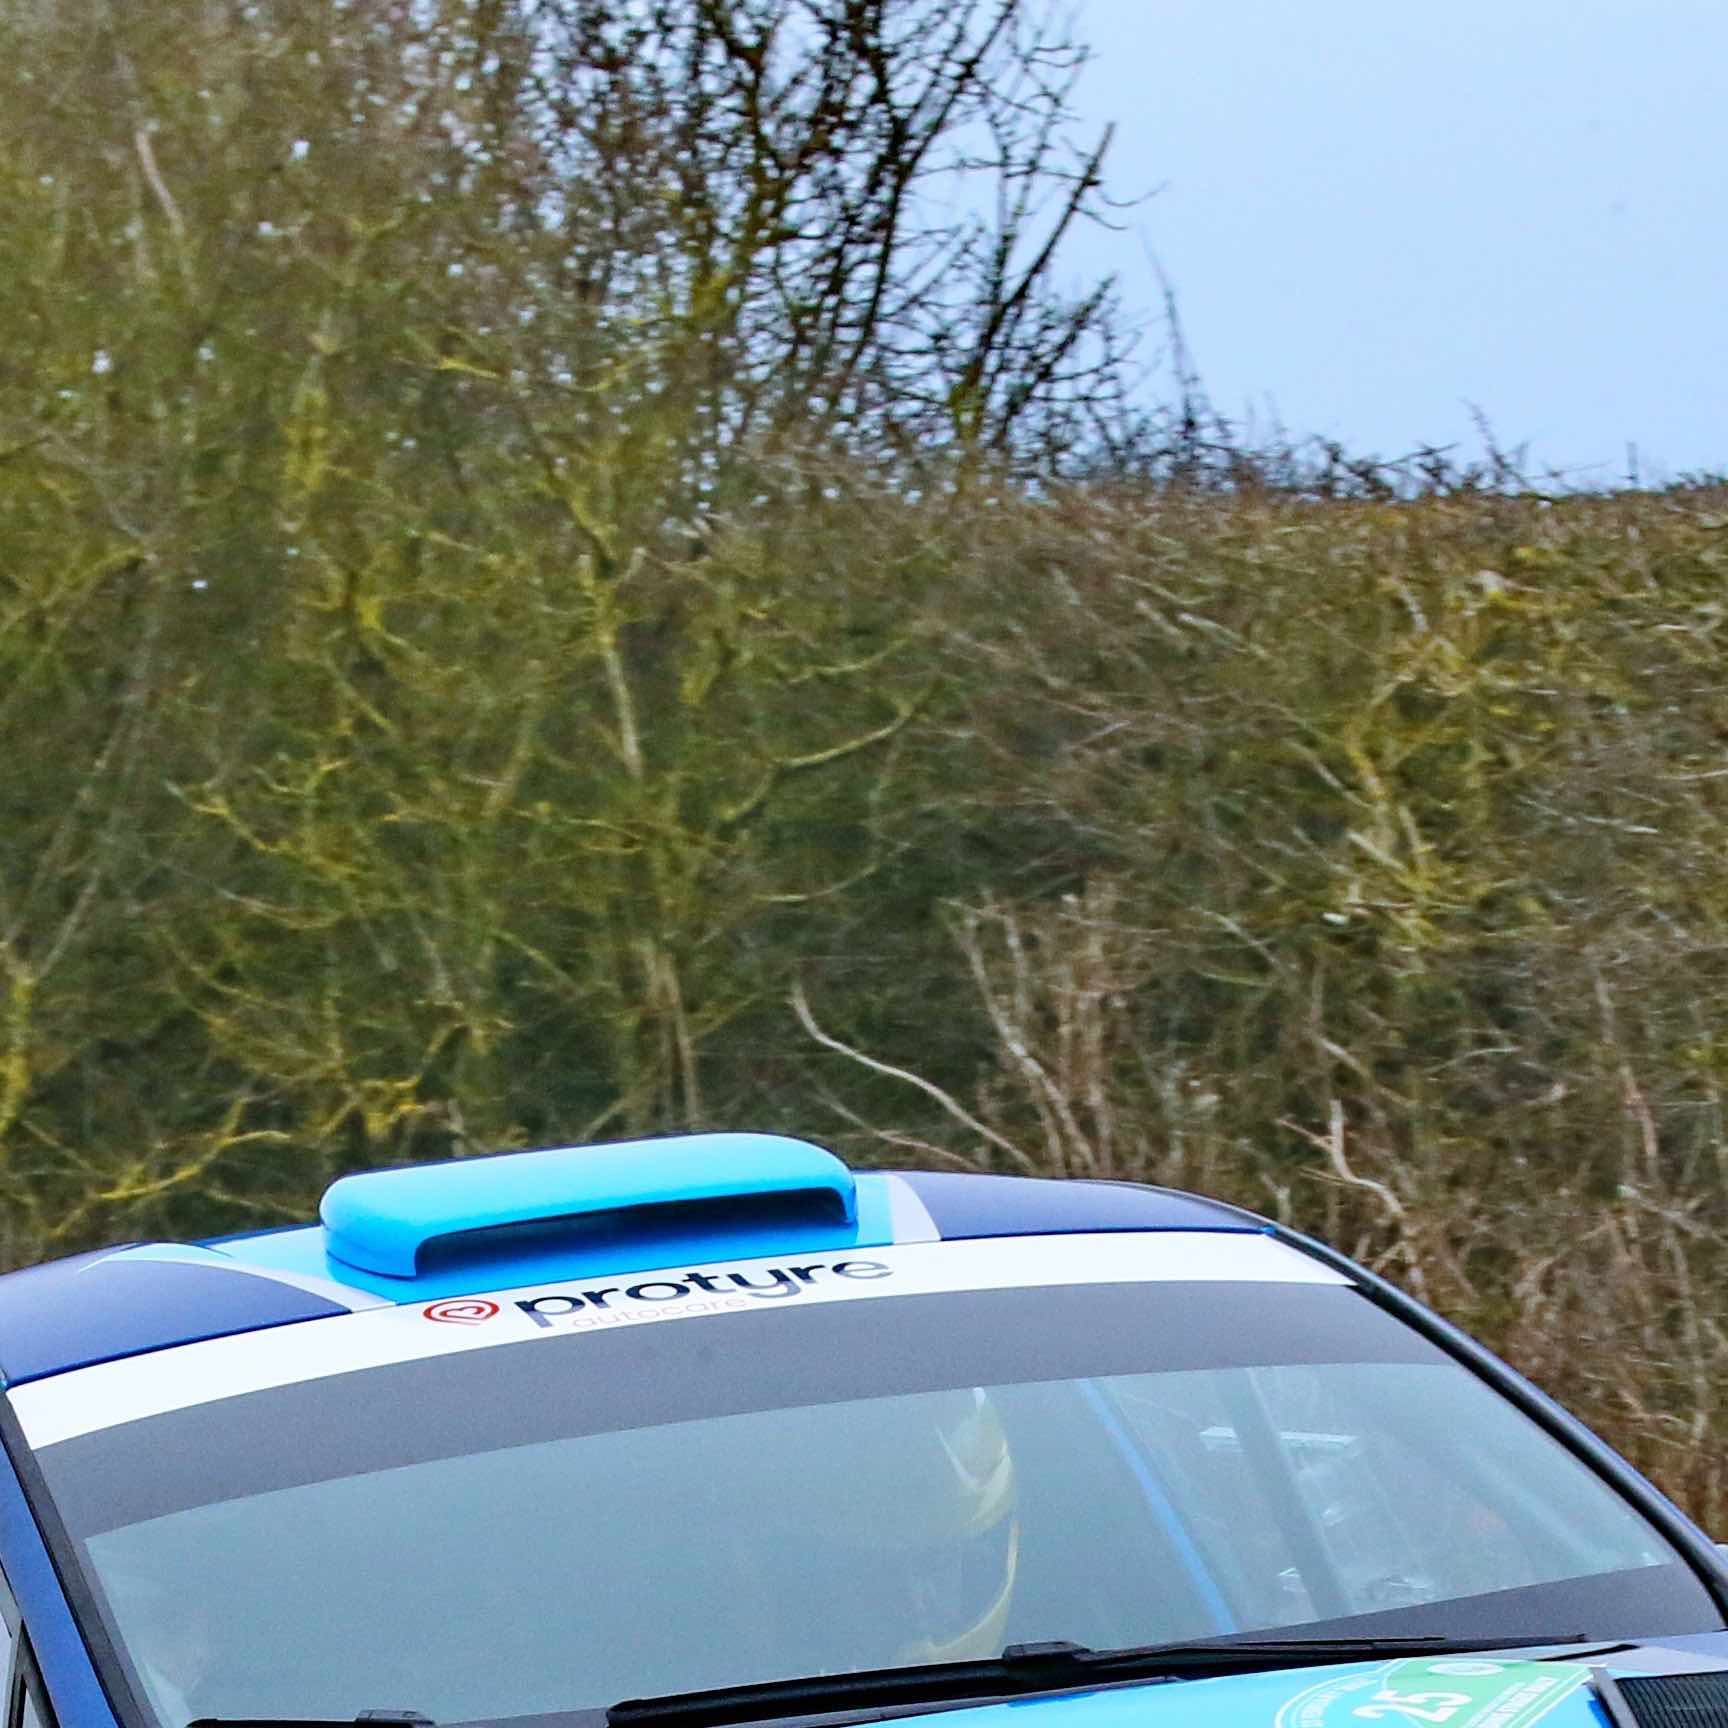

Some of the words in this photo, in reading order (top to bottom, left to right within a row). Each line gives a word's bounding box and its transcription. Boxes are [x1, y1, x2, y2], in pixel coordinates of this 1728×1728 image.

[514, 1260, 894, 1328] protyre
[572, 1297, 747, 1330] autocare
[1352, 1689, 1472, 1723] 25
